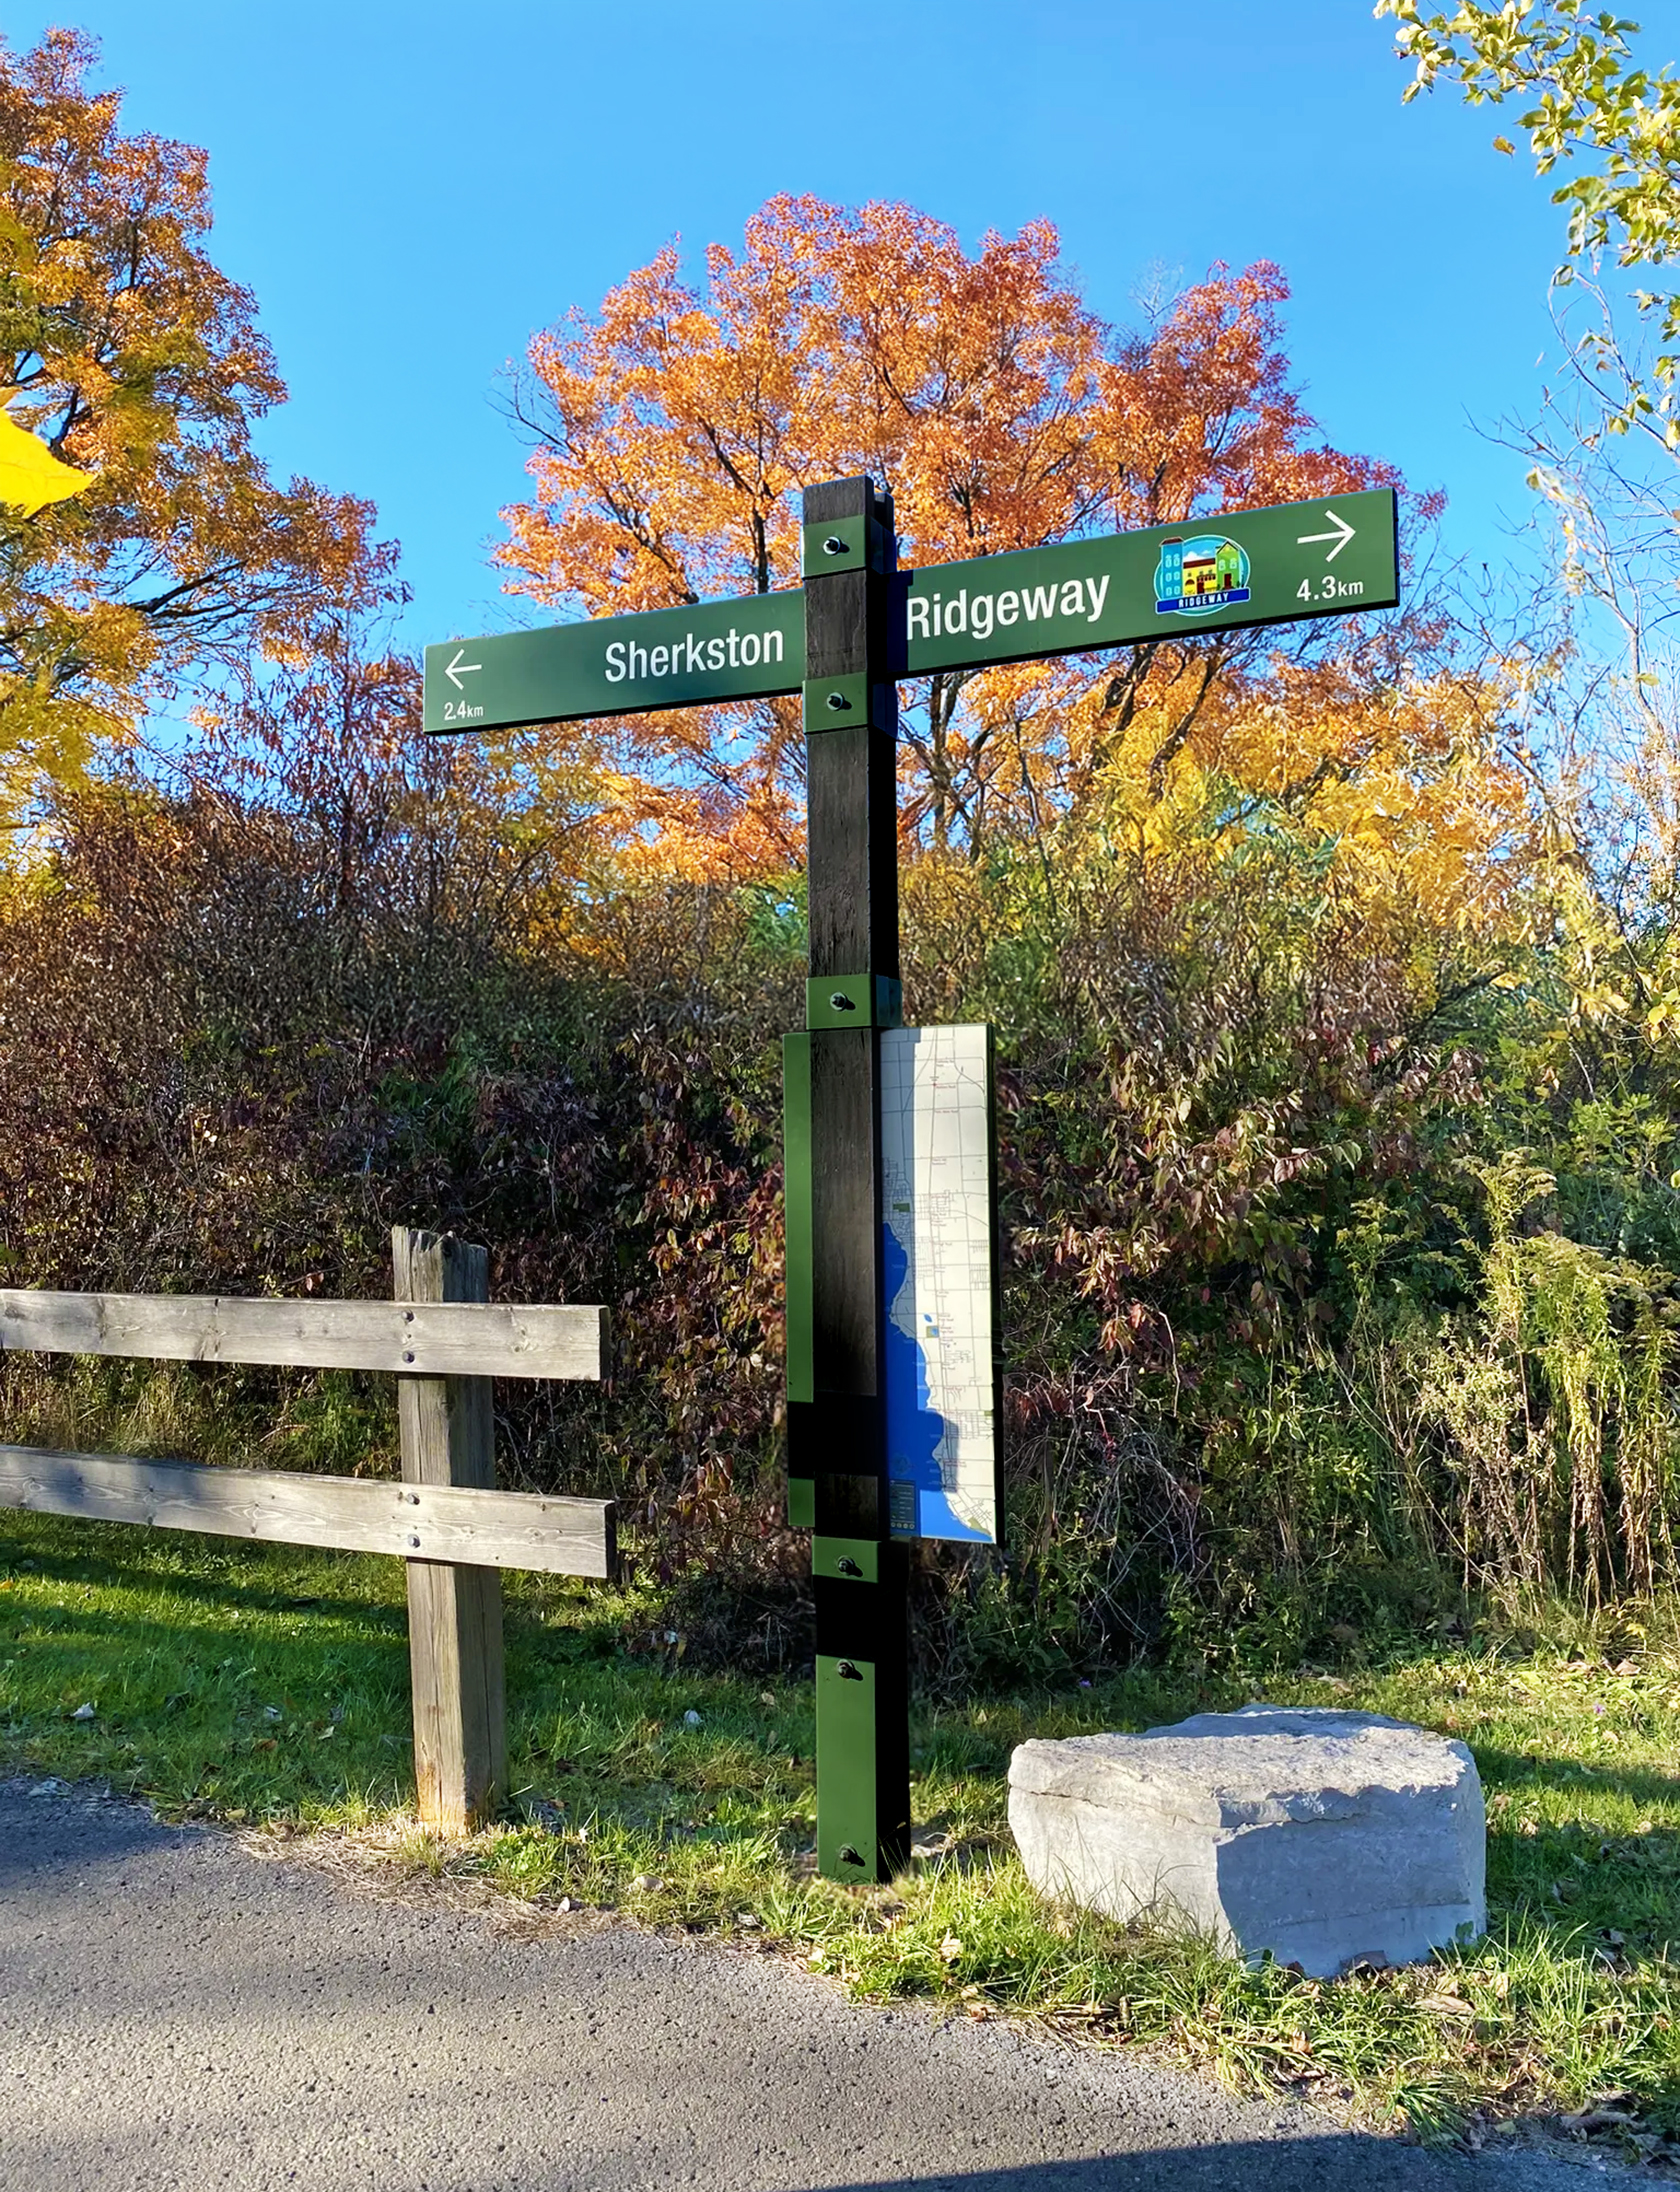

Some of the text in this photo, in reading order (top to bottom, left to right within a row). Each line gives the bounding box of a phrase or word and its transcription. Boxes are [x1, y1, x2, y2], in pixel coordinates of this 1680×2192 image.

[1178, 592, 1230, 609] RIDGEWAY
[1296, 575, 1364, 602] 4.3km
[906, 574, 1111, 640] Ridgeway
[604, 628, 783, 682] Sherkston
[443, 699, 484, 721] 2.4km
